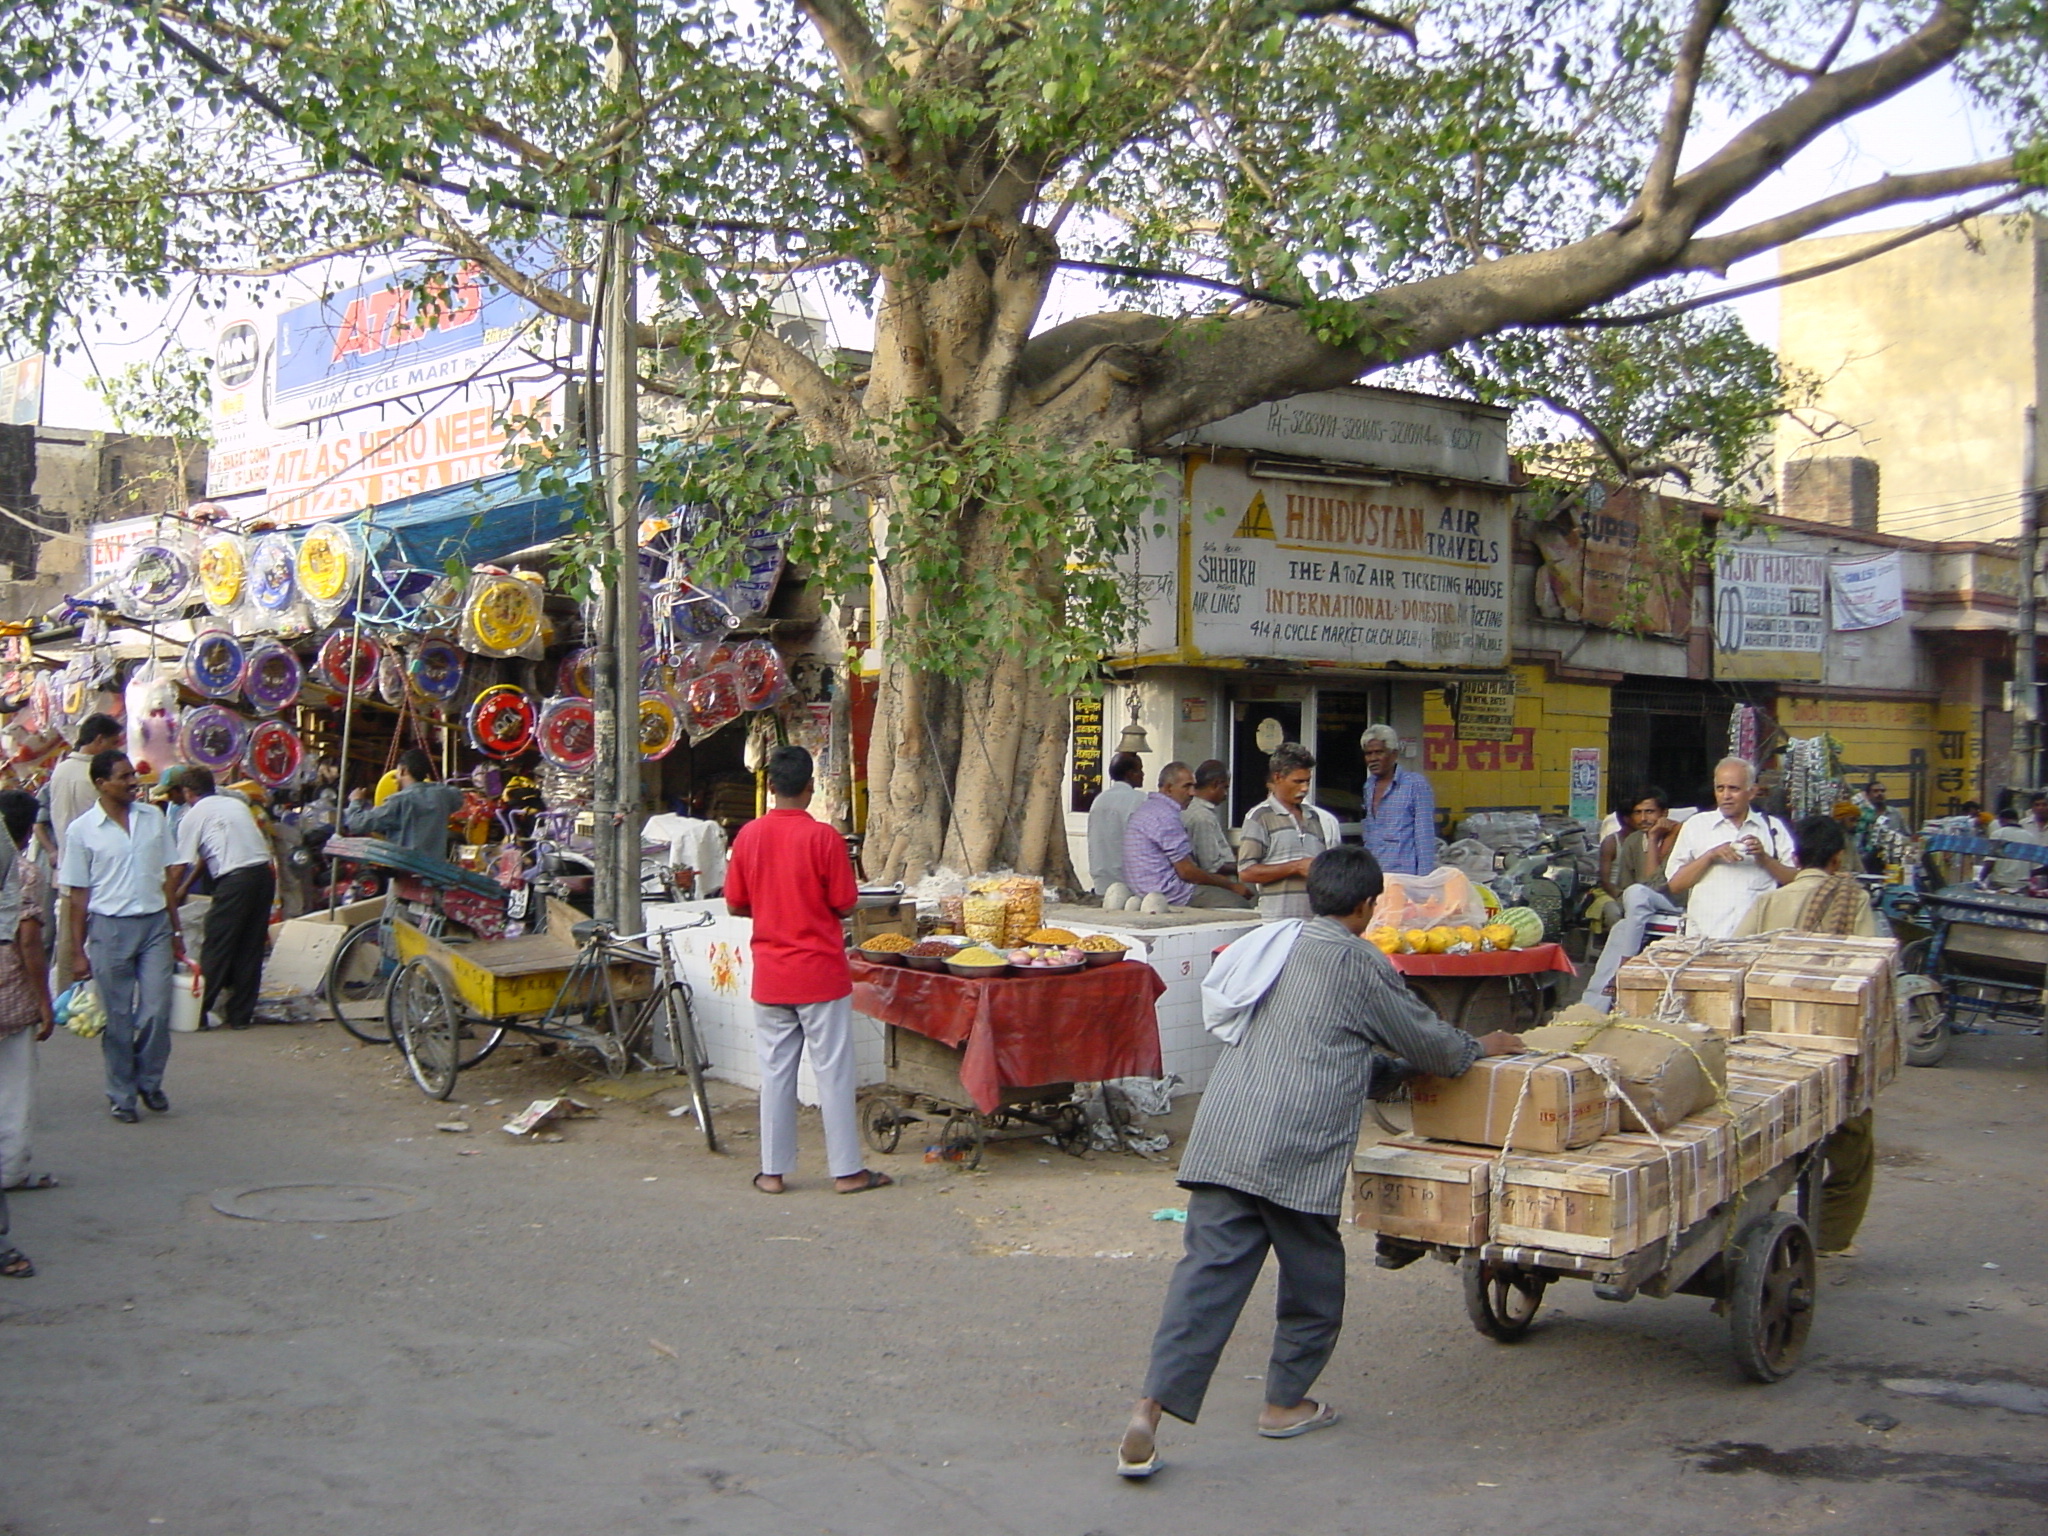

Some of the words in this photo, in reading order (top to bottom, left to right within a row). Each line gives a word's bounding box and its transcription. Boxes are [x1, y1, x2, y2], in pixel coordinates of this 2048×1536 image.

[331, 259, 482, 363] ATLAS
[307, 390, 344, 411] VIJAY
[353, 375, 398, 399] CYCLE
[407, 358, 458, 386] MART
[273, 438, 350, 486] ATLAS
[360, 424, 427, 470] HERO
[381, 460, 443, 502] BSA
[1285, 494, 1424, 551] HINDUSTAN
[1438, 506, 1480, 536] AIR
[1425, 532, 1499, 564] TRAVELS
[1720, 553, 1757, 581] VIJAY
[1329, 561, 1341, 583] A
[1369, 568, 1396, 589] AIR
[1402, 571, 1461, 595] TICKETING
[1465, 577, 1504, 599] HOUSE
[1250, 620, 1270, 638] 414
[1284, 624, 1319, 641] CYCLE
[1321, 626, 1363, 647] MARKET
